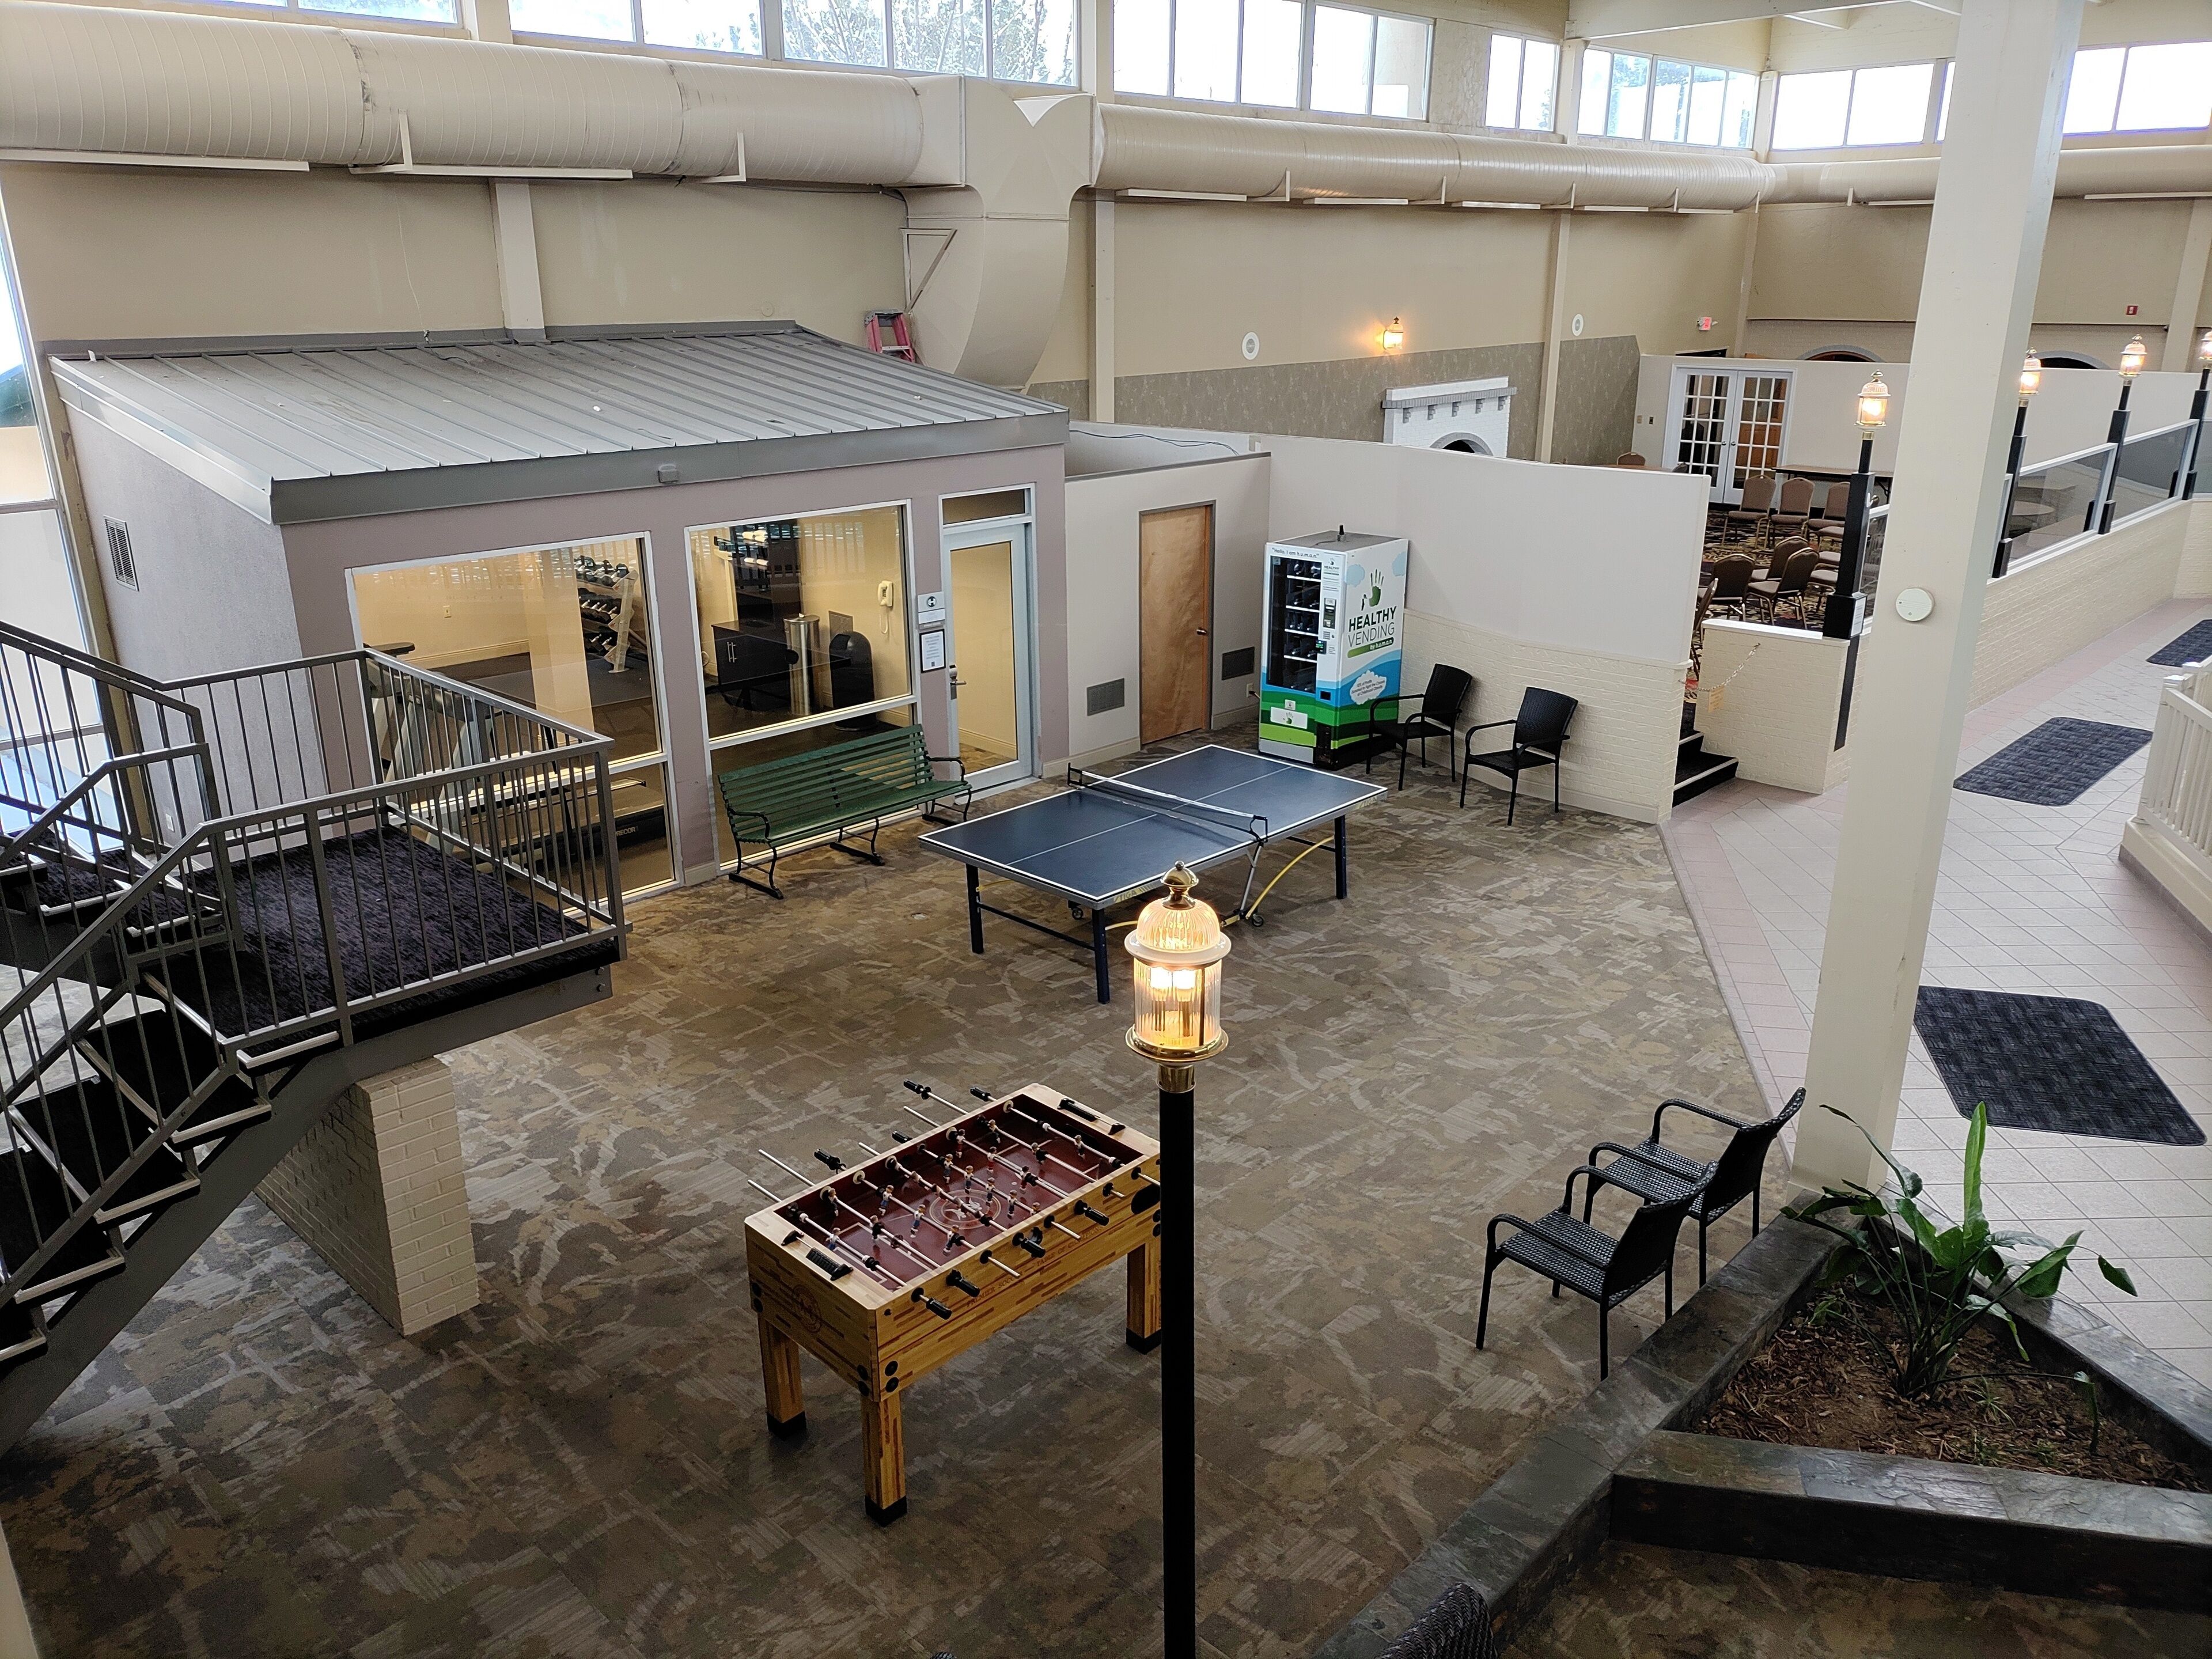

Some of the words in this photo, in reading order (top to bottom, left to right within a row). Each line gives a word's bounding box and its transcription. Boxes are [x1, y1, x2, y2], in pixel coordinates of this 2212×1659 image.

[1349, 605, 1397, 632] HEALTHY
[1348, 622, 1395, 647] VENDING
[615, 827, 636, 836] RECOR
